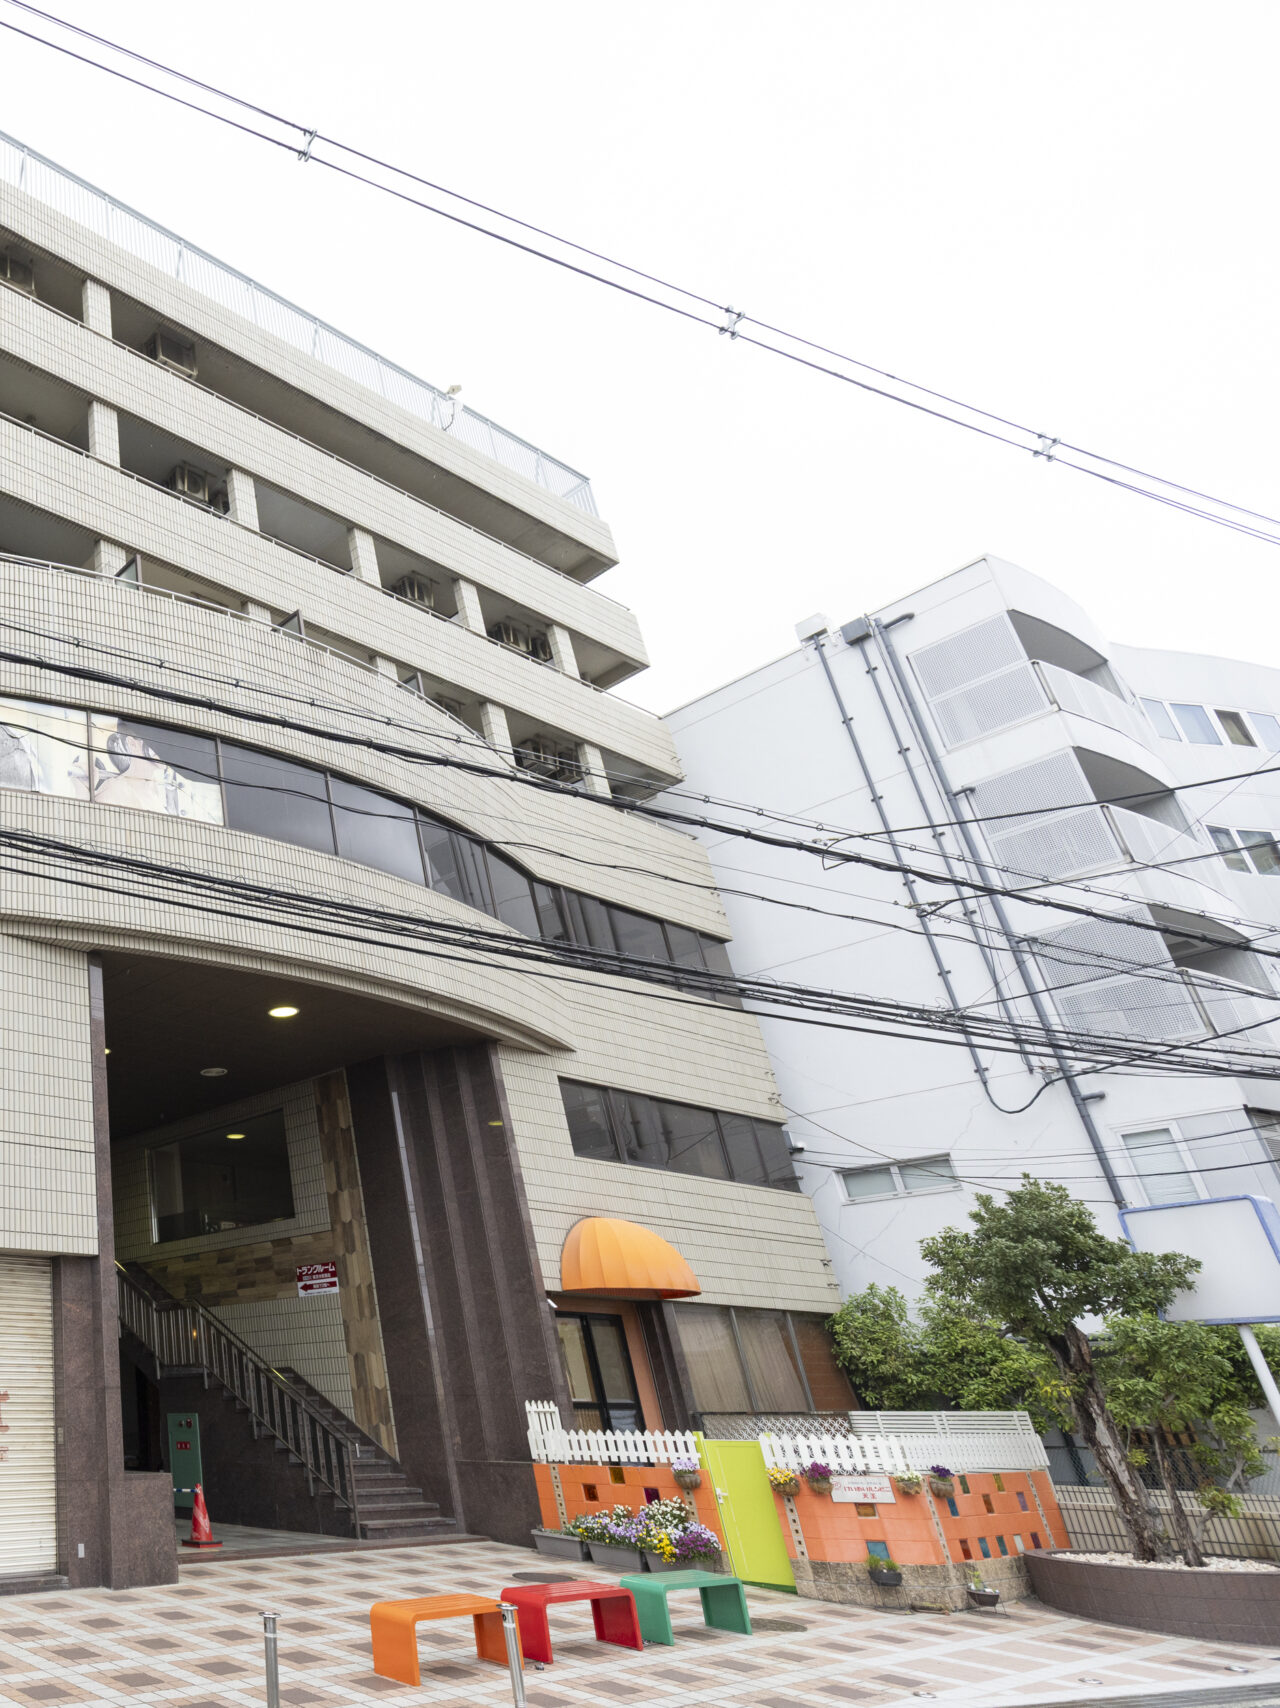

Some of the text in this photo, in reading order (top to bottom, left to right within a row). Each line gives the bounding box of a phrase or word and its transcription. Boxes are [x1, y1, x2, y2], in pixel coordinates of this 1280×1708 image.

[296, 1262, 336, 1276] トランクルーム
